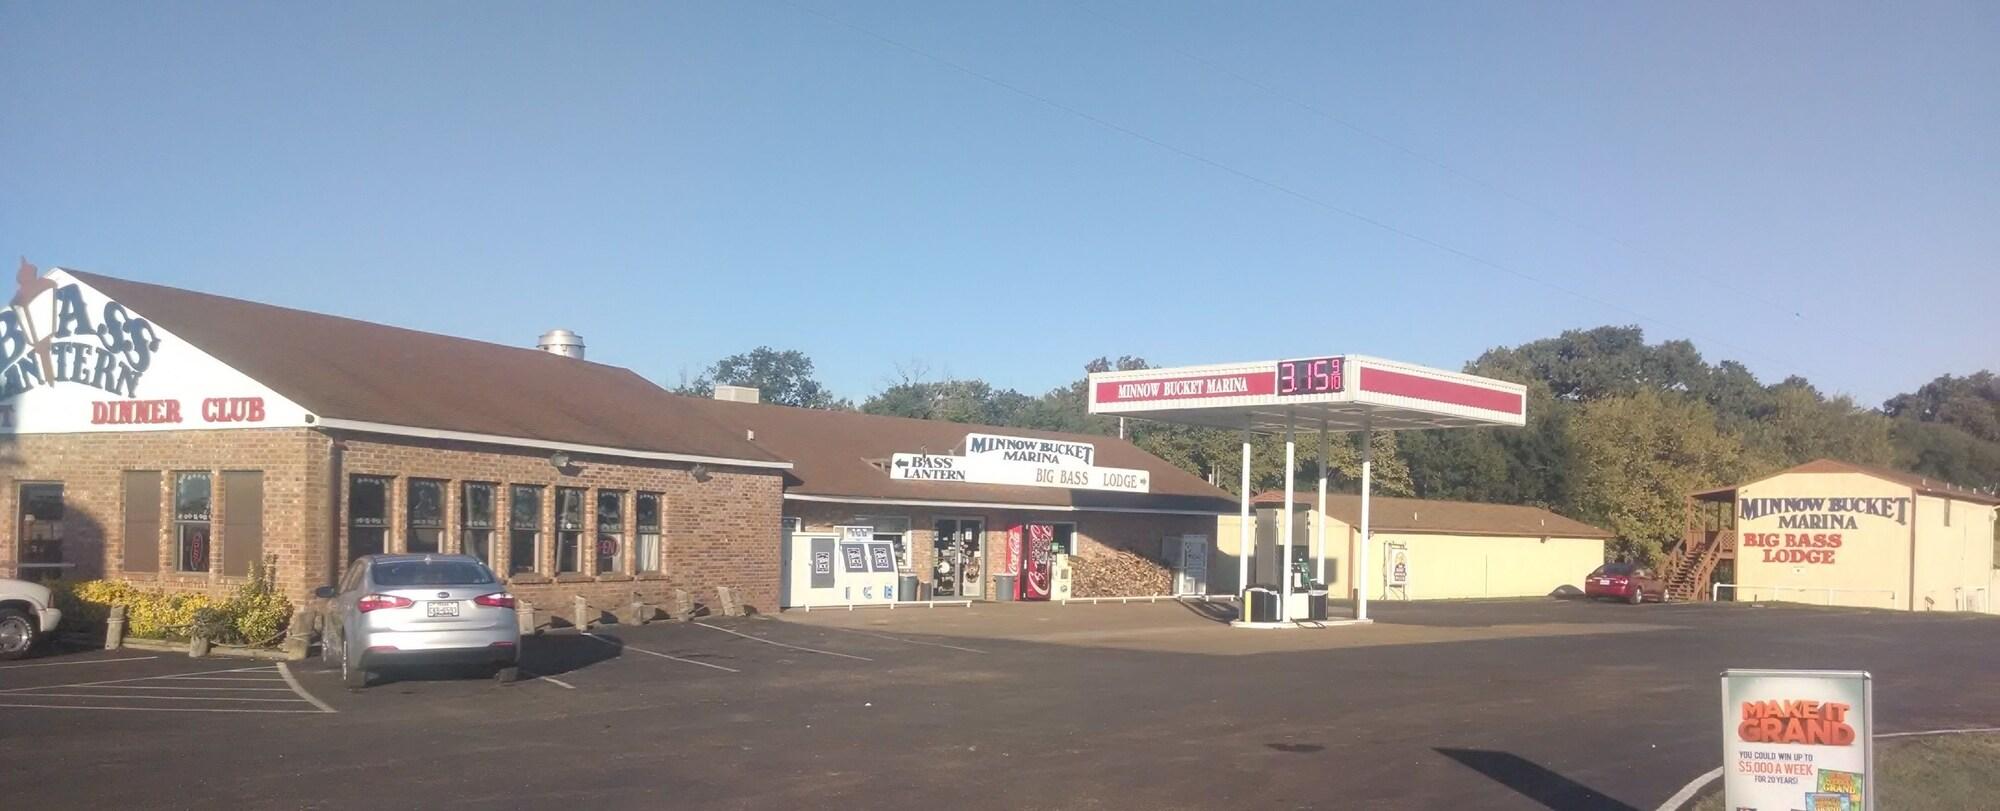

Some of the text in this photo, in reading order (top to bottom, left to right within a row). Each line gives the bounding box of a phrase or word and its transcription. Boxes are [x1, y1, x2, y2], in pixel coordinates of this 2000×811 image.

[0, 341, 143, 398] ANTERN
[1282, 360, 1328, 392] 3.15
[1118, 377, 1248, 398] MINNOW BUCKET MARINA
[91, 397, 265, 425] DINNER CLUB
[971, 437, 1094, 464] MINNOW BUCKET
[1003, 451, 1060, 464] MARINA
[911, 456, 953, 469] BASS
[904, 468, 966, 480] LANTERN
[1036, 468, 1137, 488] BIG BASS LODGE
[1739, 497, 1911, 526] MINNOW BUCKET
[1778, 514, 1858, 529] MARINA
[1744, 533, 1842, 548] BIG BASS
[1763, 549, 1835, 564] LODGE
[1742, 699, 1850, 722] MAKE IT
[1738, 717, 1855, 746] GRAND
[1739, 751, 1813, 761] YOU COULD WIN UP TO
[1739, 761, 1813, 776] $5,000 A WEEK
[1754, 775, 1799, 784] FOR 20 YEARS!
